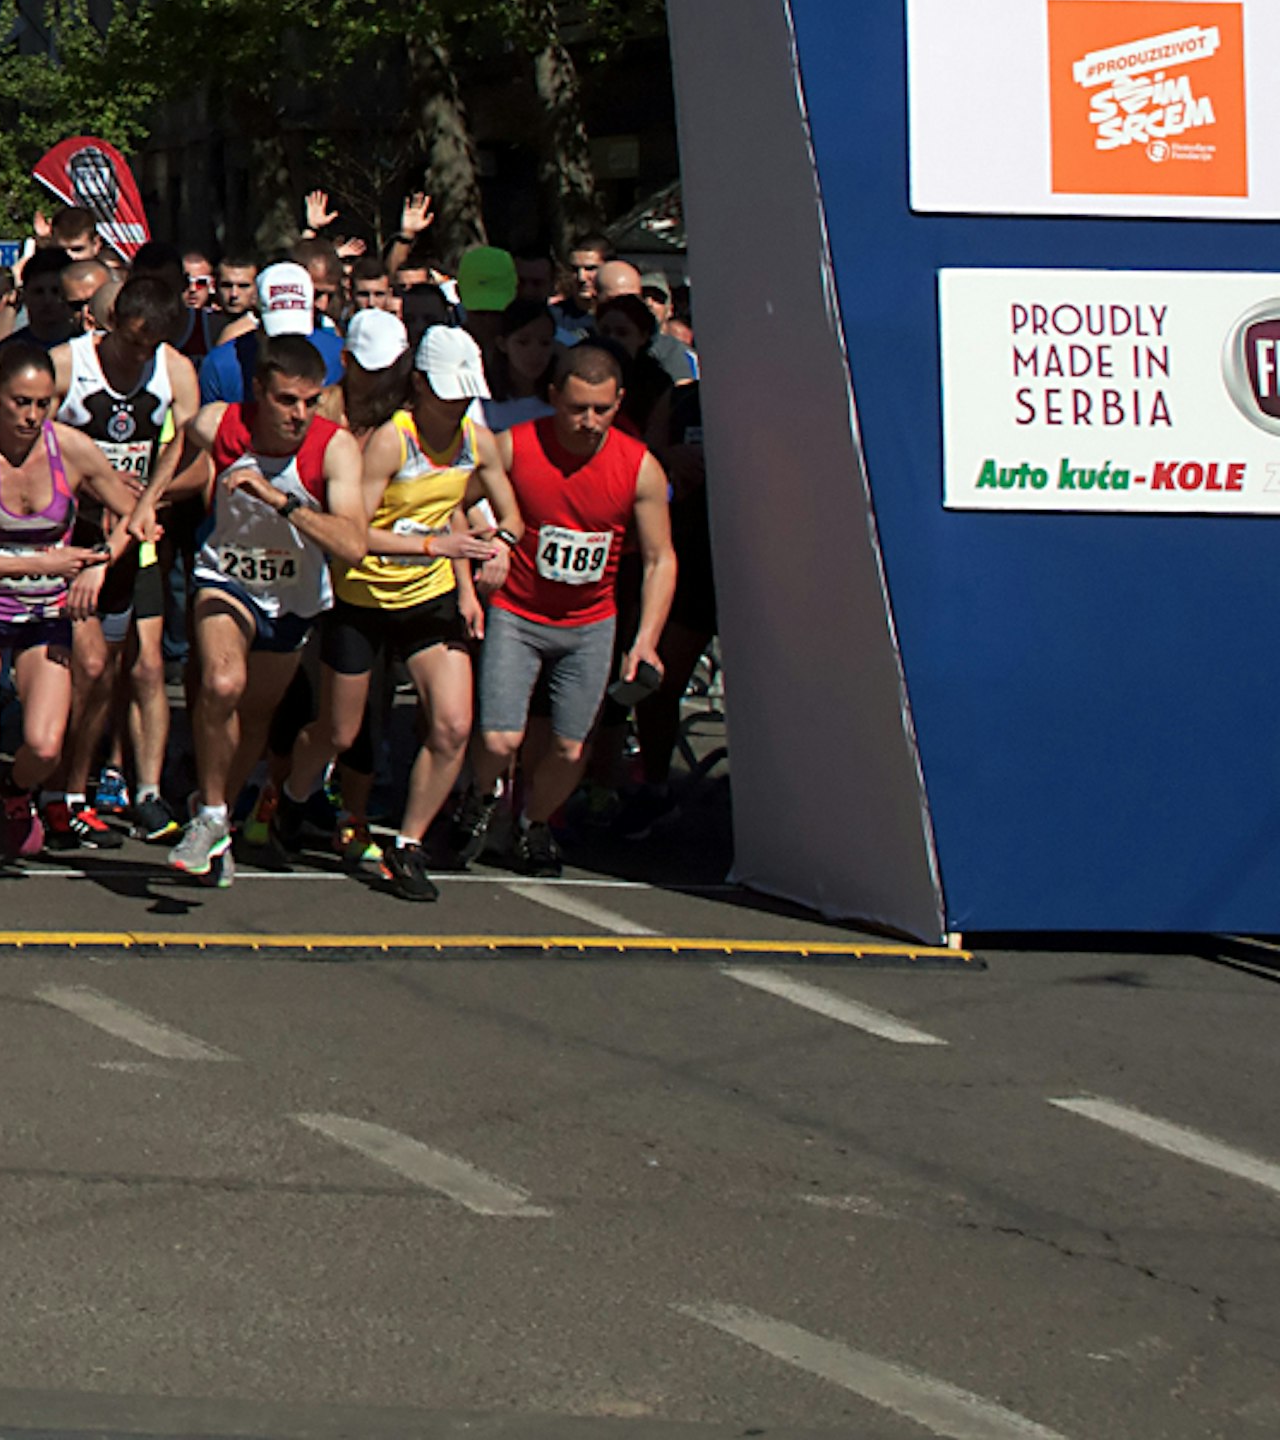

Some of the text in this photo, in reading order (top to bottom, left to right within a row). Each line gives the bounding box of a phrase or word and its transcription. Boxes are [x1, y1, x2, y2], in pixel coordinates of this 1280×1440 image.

[1086, 35, 1207, 78] #PRODUZIZIVOT
[1095, 96, 1217, 151] SRCEM
[1011, 303, 1168, 337] PROUDLY
[1013, 344, 1170, 379] MADE IN
[1015, 388, 1173, 428] SERBIA
[975, 458, 1050, 490] Auto
[223, 551, 297, 581] 2354
[541, 542, 606, 572] 4189
